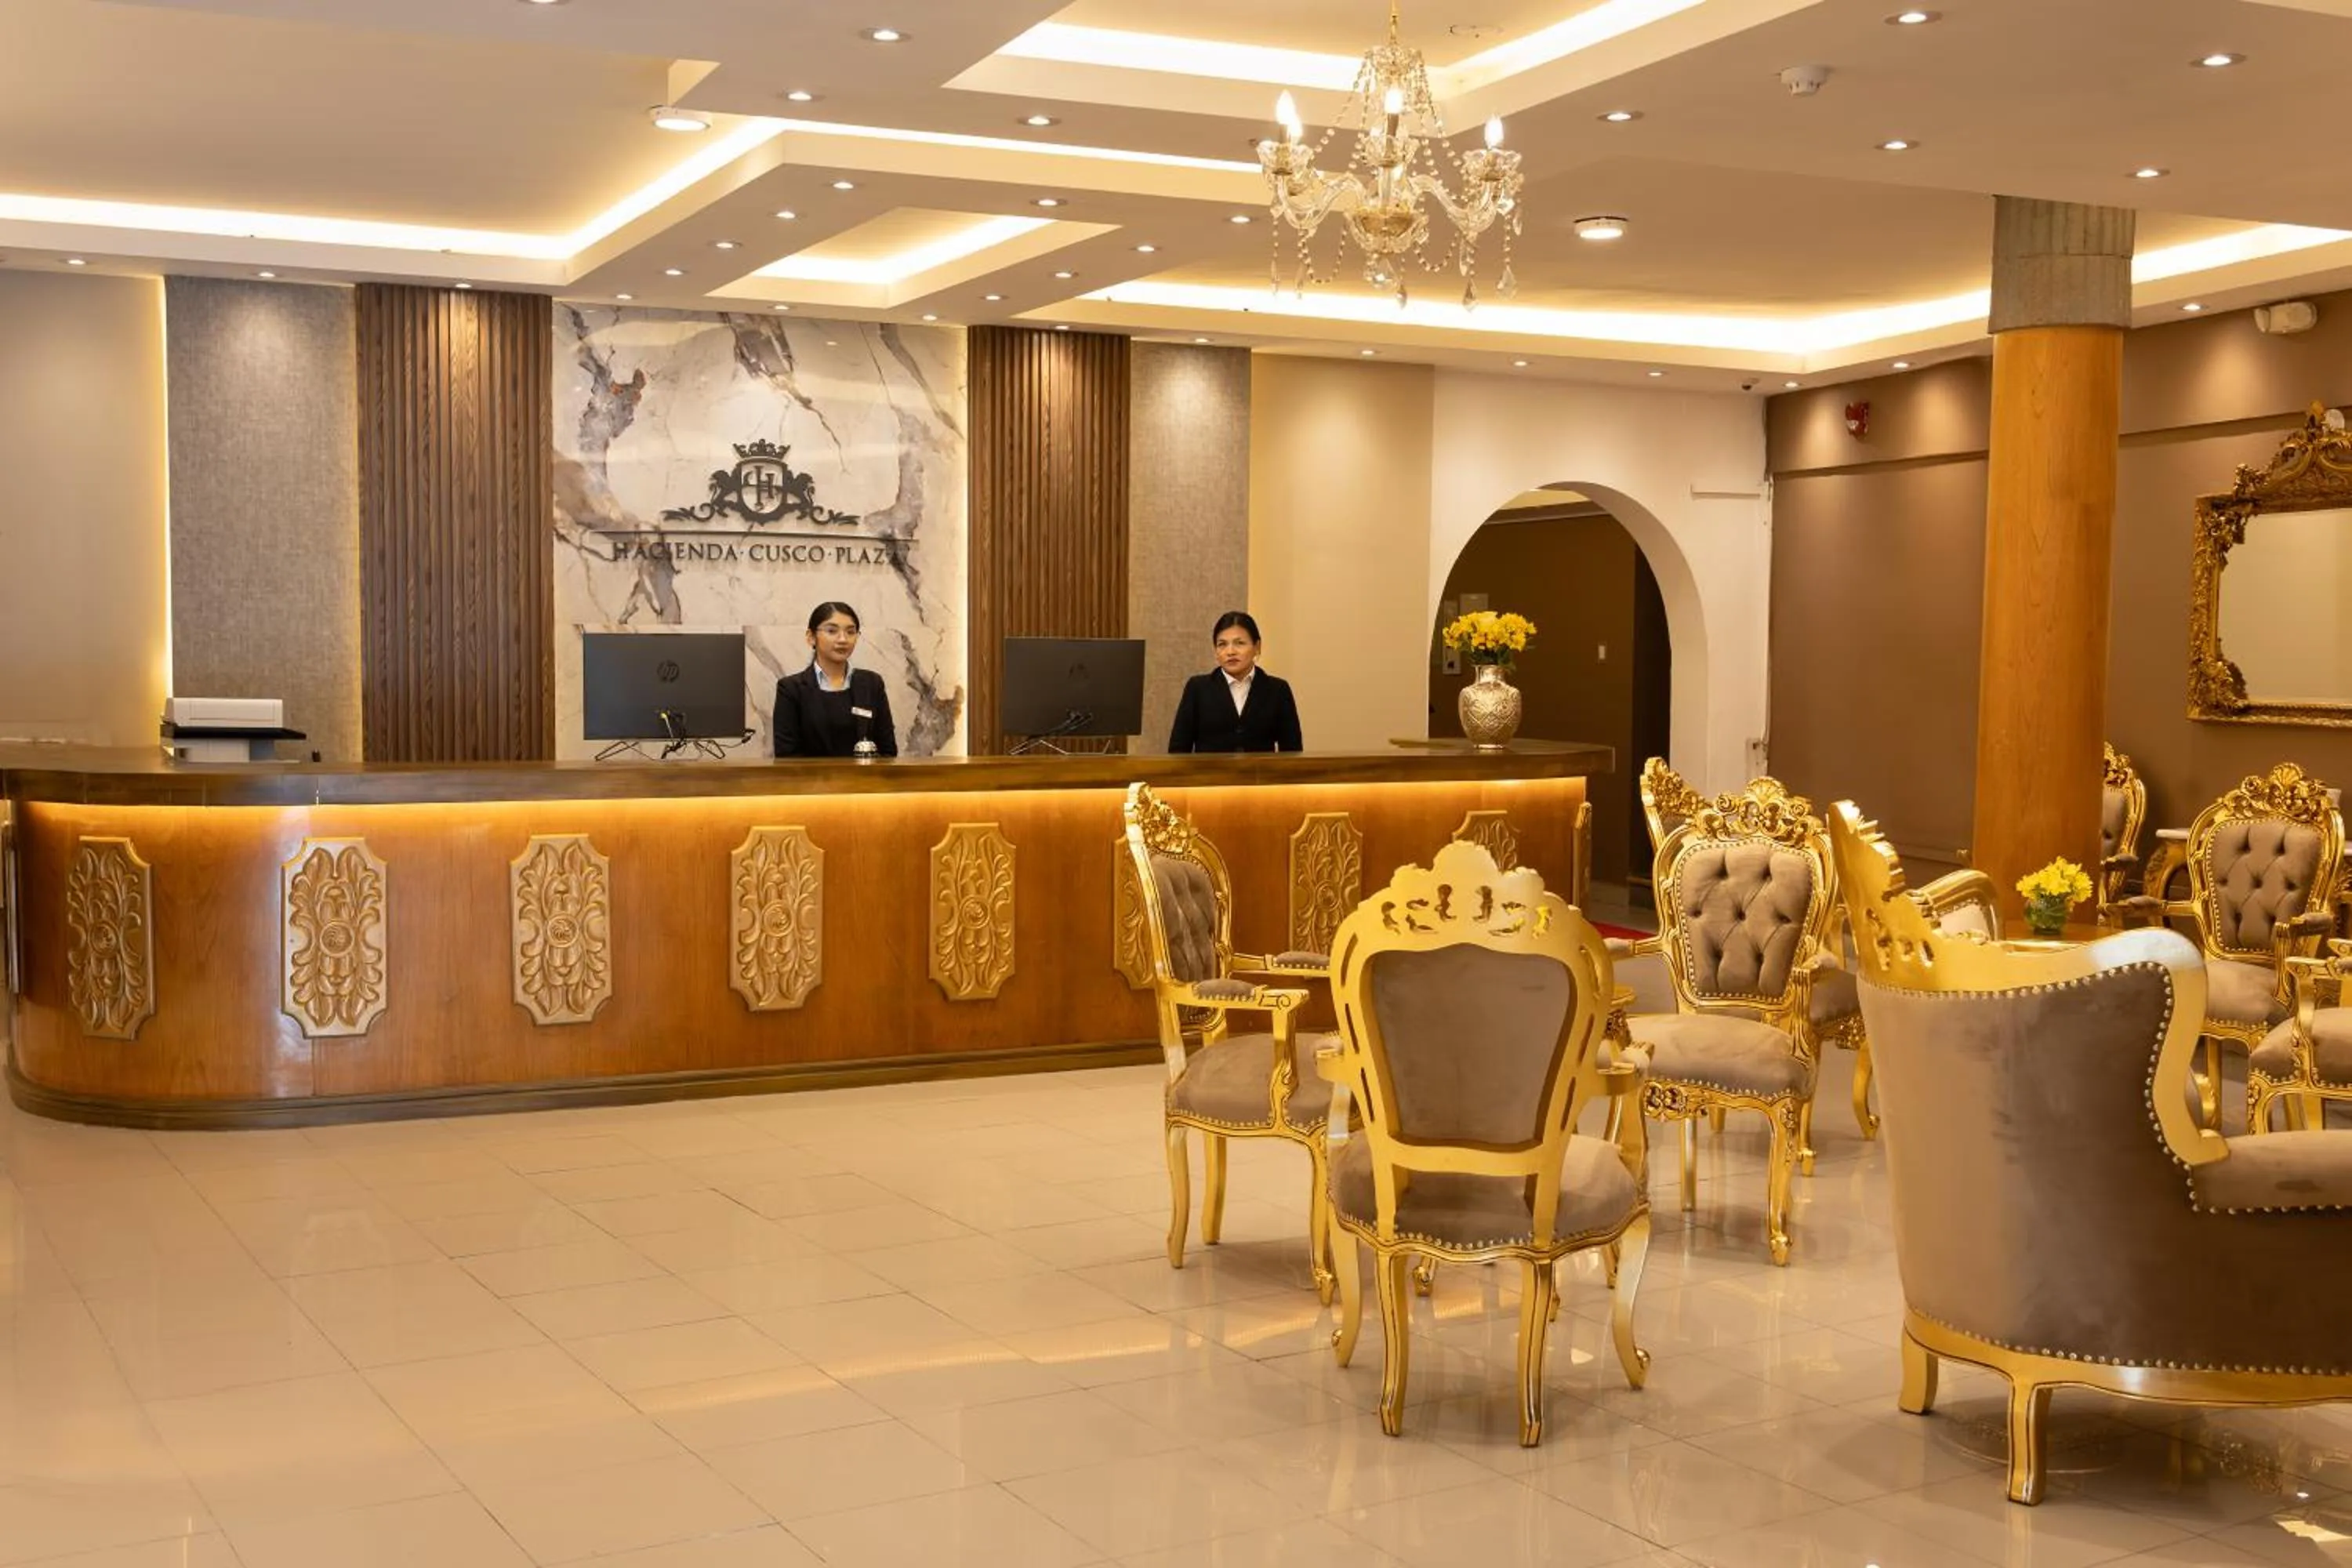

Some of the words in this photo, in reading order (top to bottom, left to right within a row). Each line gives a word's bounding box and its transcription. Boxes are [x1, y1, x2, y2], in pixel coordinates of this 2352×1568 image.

[613, 542, 738, 561] HACIENDA
[749, 543, 825, 563] CUSCO
[657, 660, 680, 683] hp
